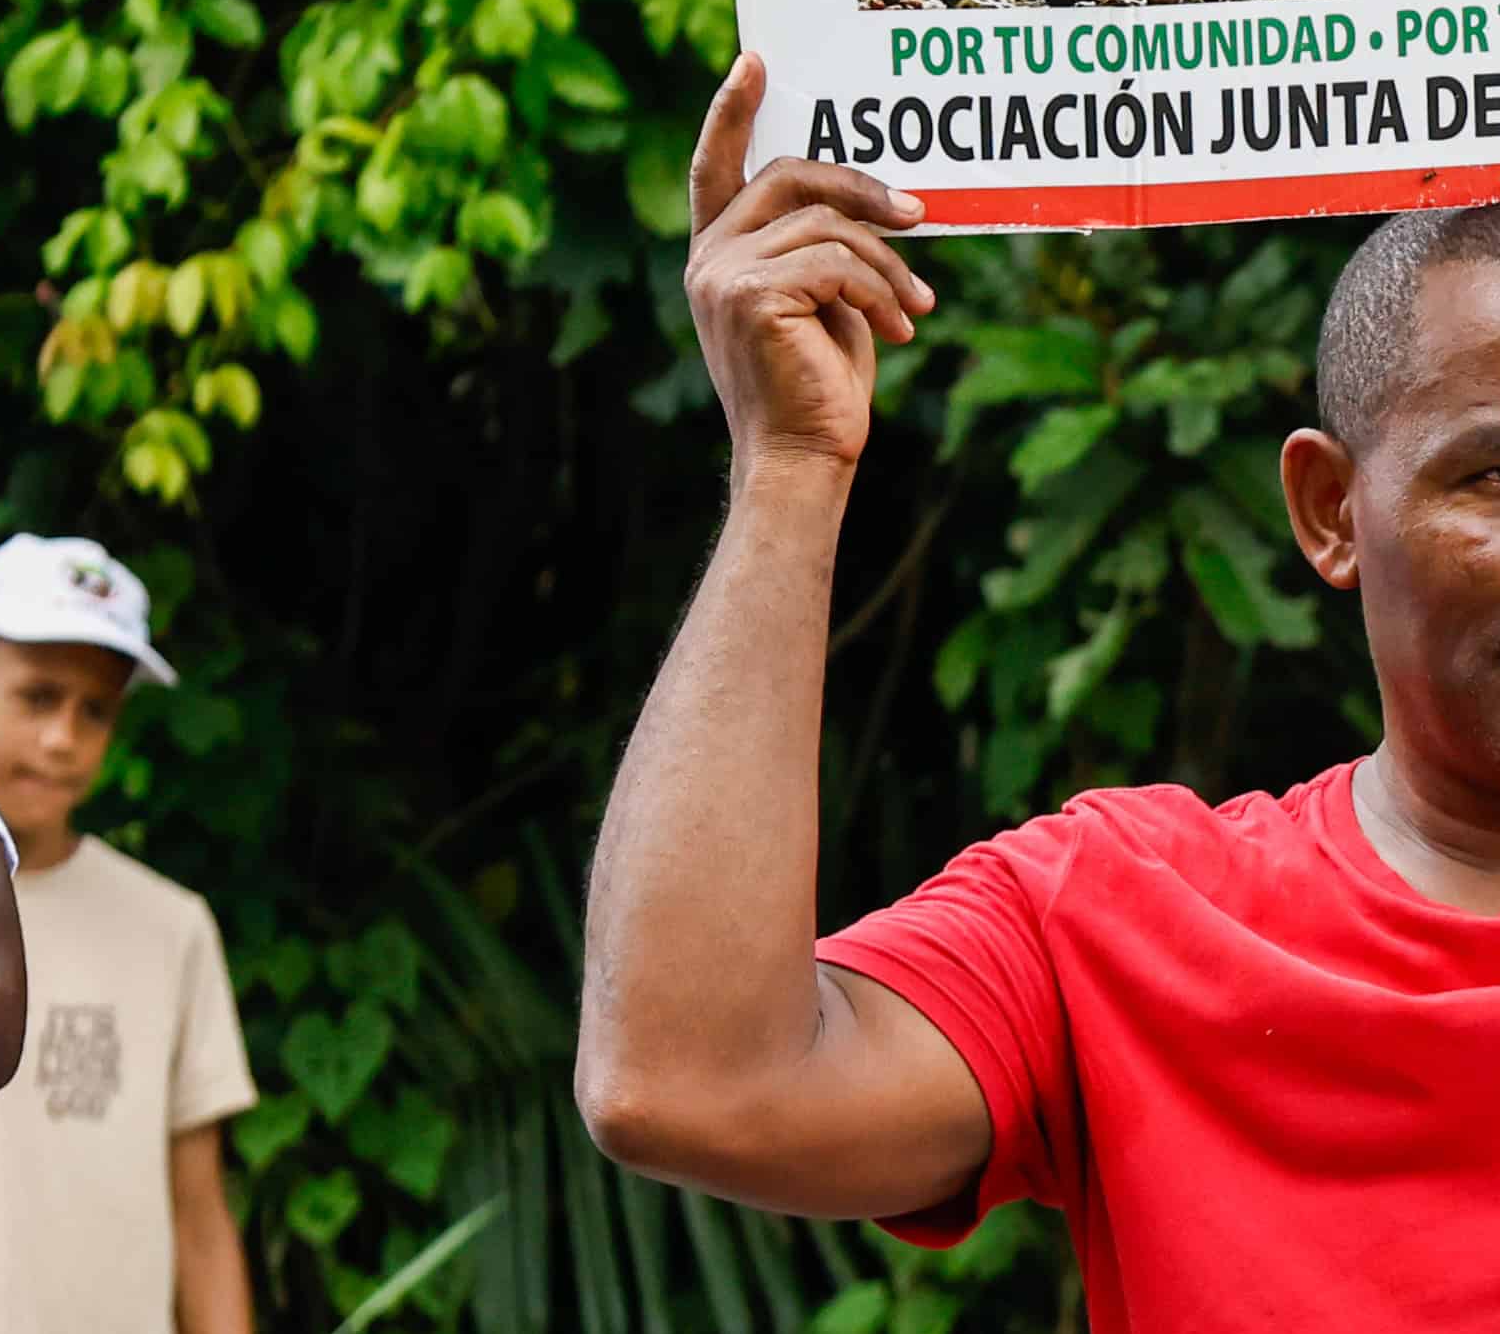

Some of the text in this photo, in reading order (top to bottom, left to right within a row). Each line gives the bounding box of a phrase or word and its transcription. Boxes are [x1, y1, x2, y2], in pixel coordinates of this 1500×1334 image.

[891, 26, 986, 77] POR
[994, 25, 1055, 75] TU
[1067, 13, 1357, 75] COMUNIDAD
[1397, 5, 1490, 59] POR
[805, 79, 1195, 166] ASOCIACIÓN
[1209, 79, 1410, 156] JUNTA
